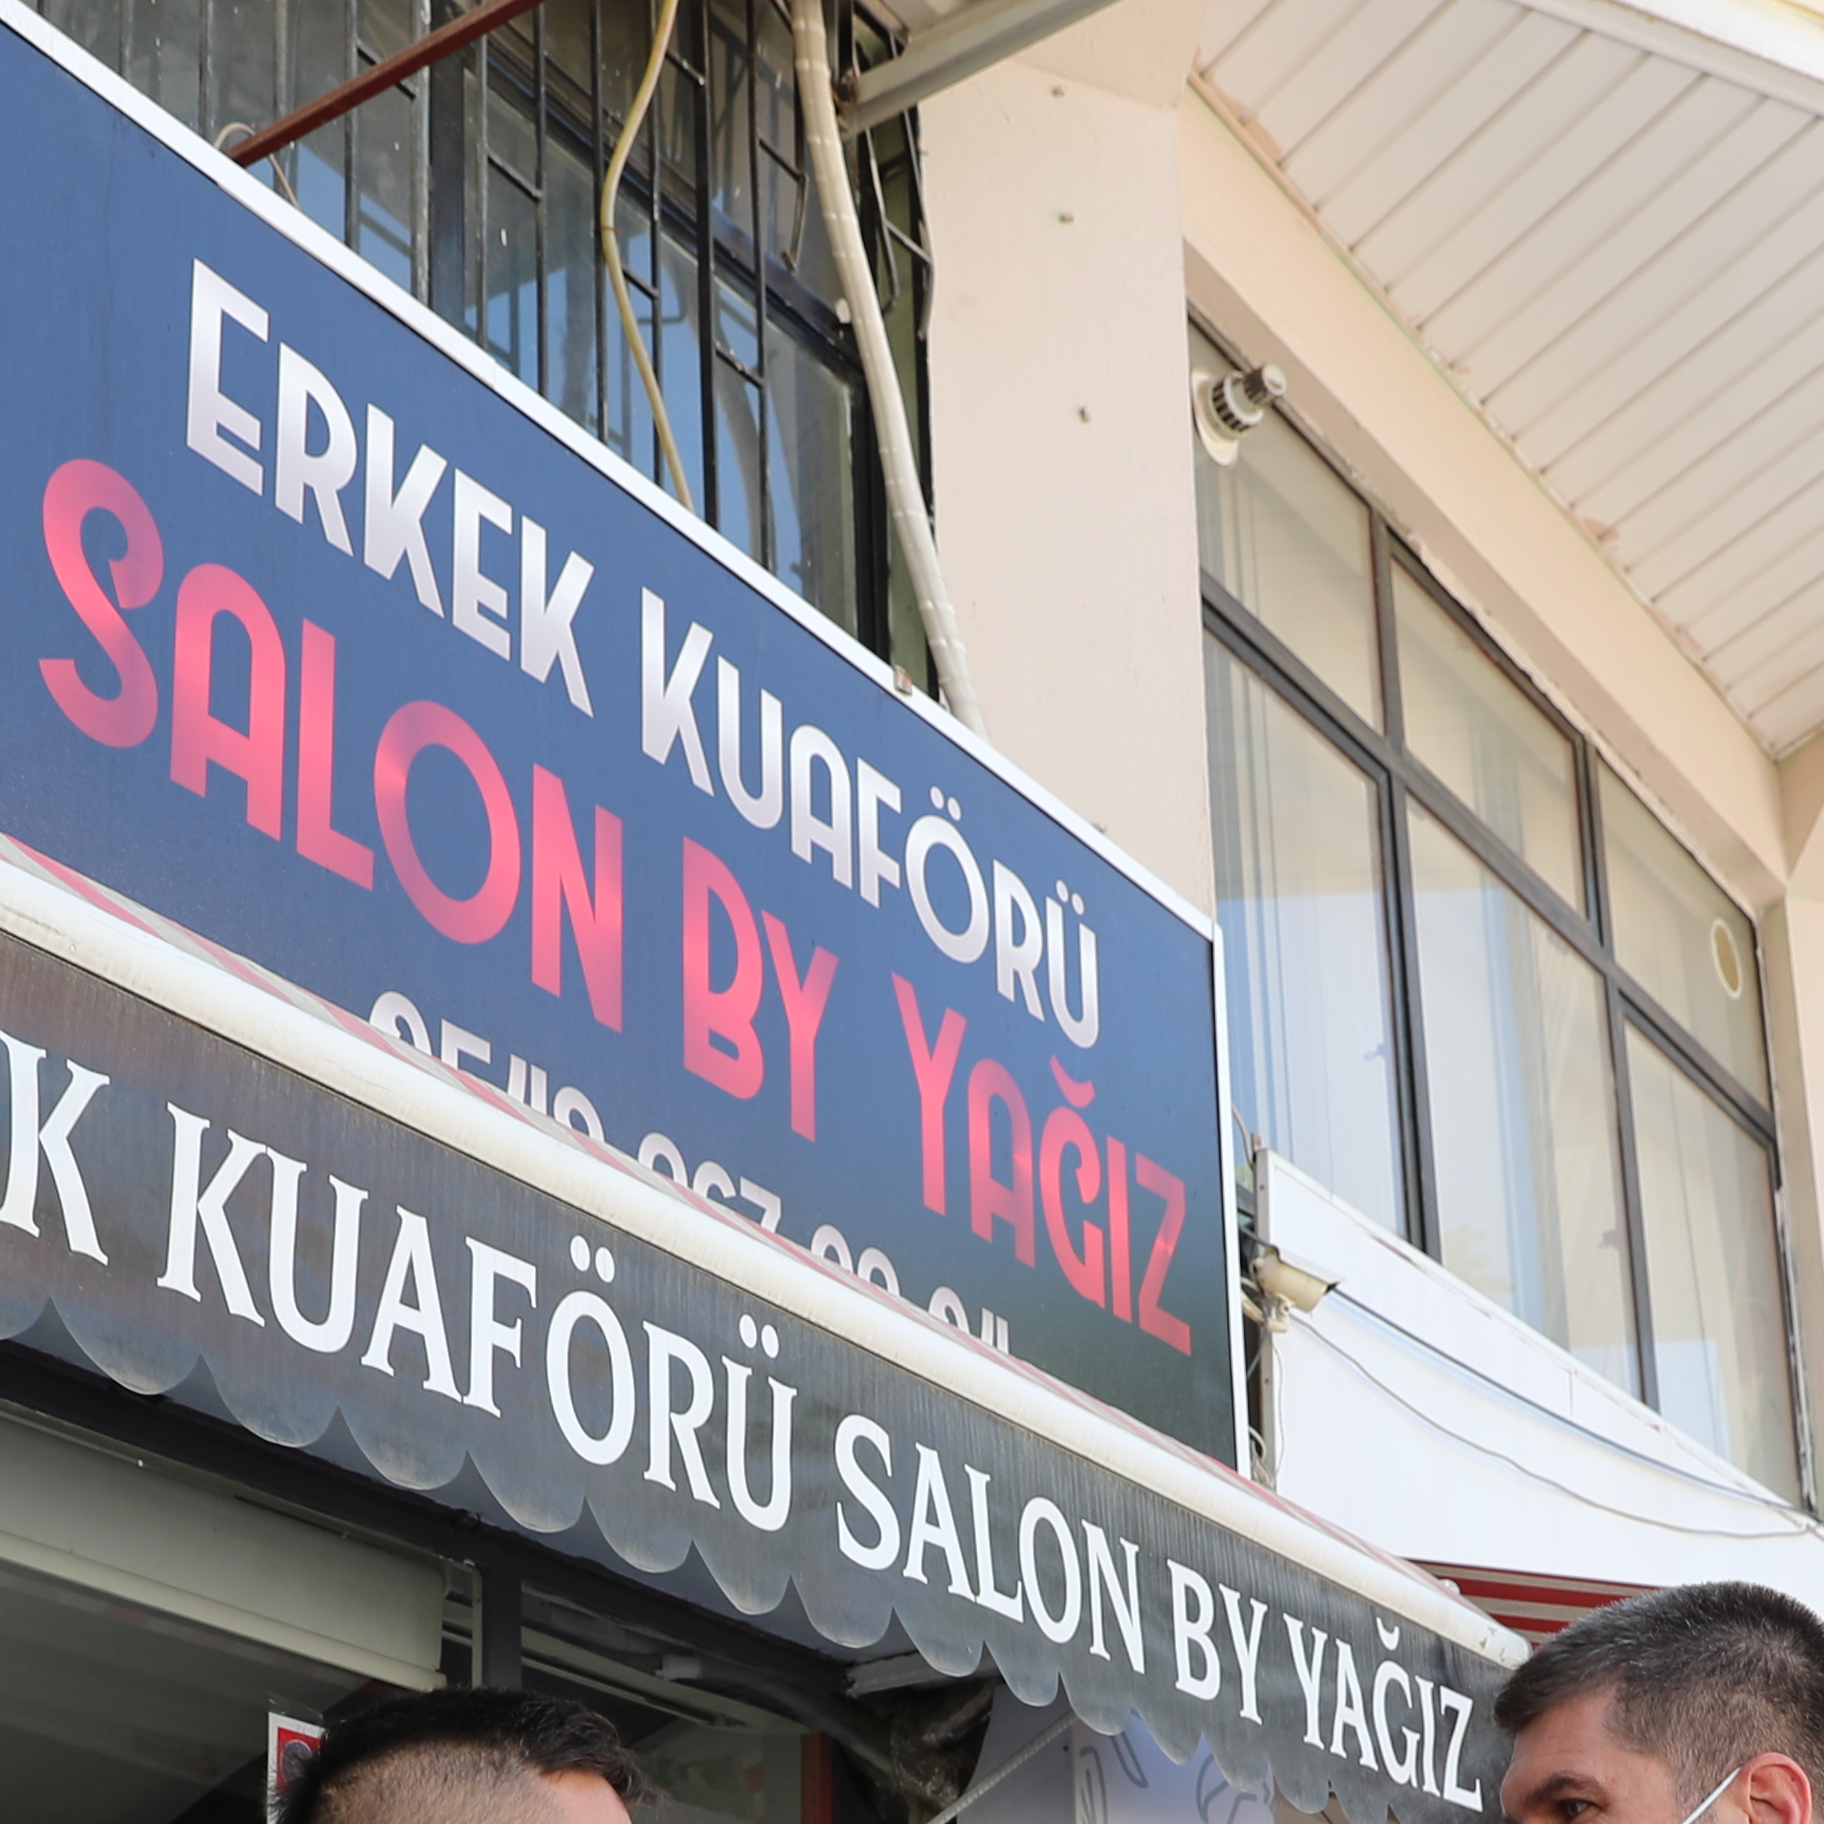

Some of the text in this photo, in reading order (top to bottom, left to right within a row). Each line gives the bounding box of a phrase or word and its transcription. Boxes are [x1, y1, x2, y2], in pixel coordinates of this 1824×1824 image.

[38, 458, 625, 1033] SALON
[681, 835, 840, 1143] BY
[891, 972, 1193, 1357] YAĞIZ
[186, 258, 1102, 1050] ERKEK KUAFÖRÜ
[157, 1103, 796, 1532] KUAFÖRÜ
[834, 1414, 1146, 1675] SALON
[1166, 1558, 1266, 1726] BY
[1282, 1613, 1484, 1811] YAĞIZ
